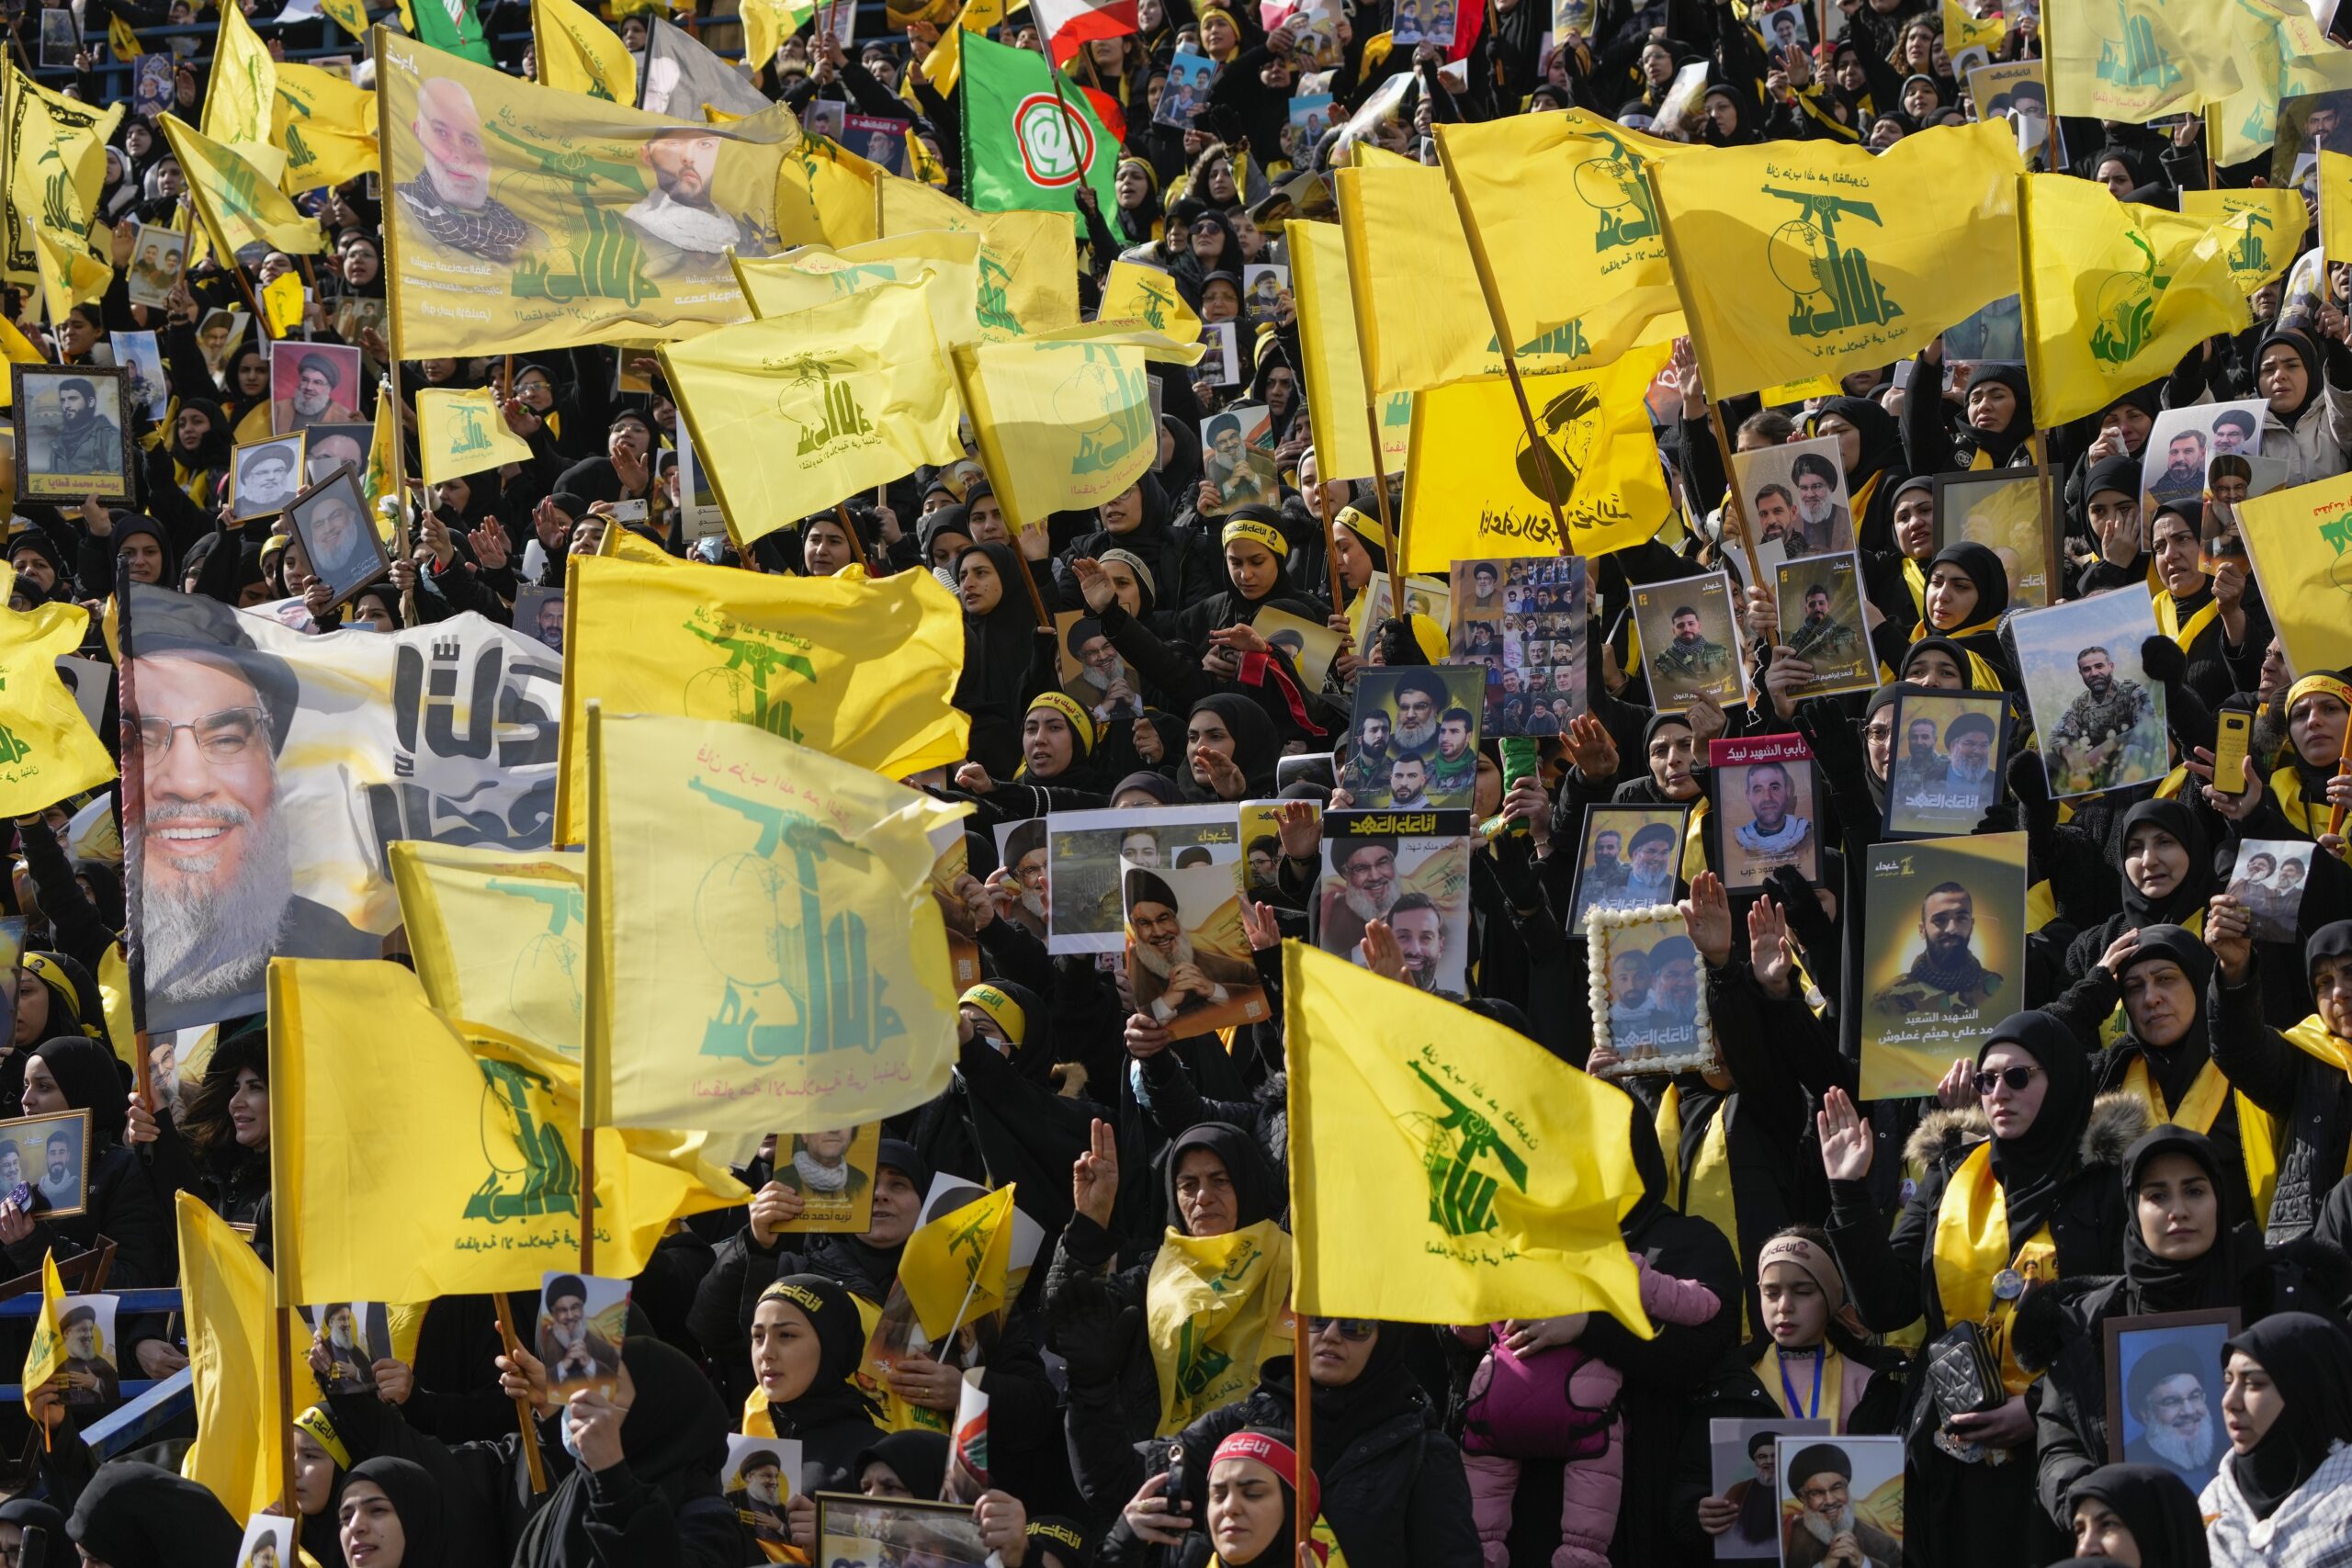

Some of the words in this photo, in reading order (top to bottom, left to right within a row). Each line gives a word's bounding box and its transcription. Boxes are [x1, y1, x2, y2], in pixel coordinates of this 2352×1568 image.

[77, 479, 94, 489] محمد
[96, 480, 120, 491] يوسف
[2312, 502, 2346, 517] المقاومة
[1833, 560, 1851, 570] شهداء
[1702, 581, 1723, 591] شهداء
[1820, 670, 1841, 682] إبراهيم
[1840, 669, 1853, 678] أحمد
[1059, 699, 1076, 715] لبيك
[1749, 741, 1781, 760] الشهيد
[1784, 739, 1807, 758] بأبي
[1905, 792, 1946, 809] العهد
[1944, 792, 1966, 808] على
[1350, 814, 1396, 836] العهد
[1396, 815, 1421, 834] على
[1197, 829, 1232, 842] شهداء
[1739, 867, 1756, 877] حرب
[1874, 860, 1899, 873] شهداء
[1942, 1008, 1979, 1023] الشهيد
[1657, 1027, 1679, 1044] على
[1877, 1029, 1920, 1044] غملوش
[1921, 1025, 1950, 1044] هيثم
[1952, 1025, 1976, 1042] علي
[1978, 1025, 1994, 1035] مد
[811, 1210, 834, 1222] أحمد
[834, 1212, 853, 1224] نزيه
[1770, 1245, 1786, 1256] على
[1228, 1438, 1256, 1453] على
